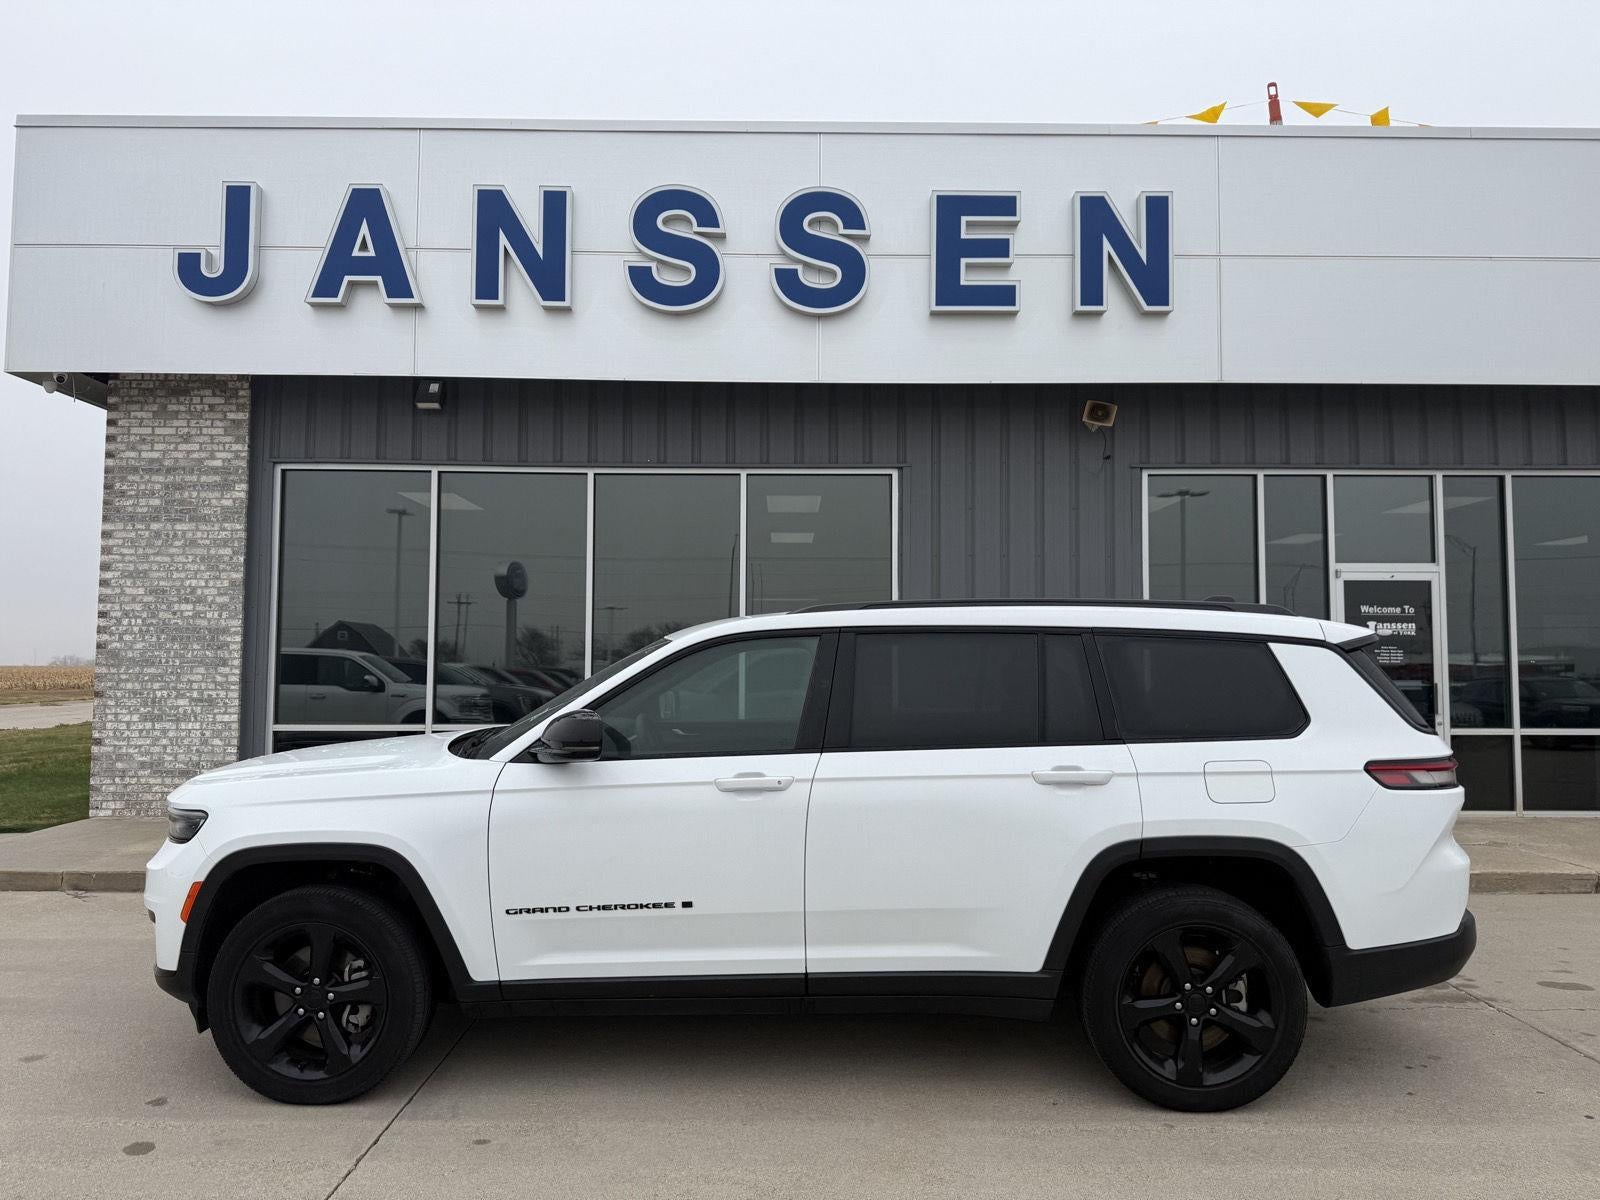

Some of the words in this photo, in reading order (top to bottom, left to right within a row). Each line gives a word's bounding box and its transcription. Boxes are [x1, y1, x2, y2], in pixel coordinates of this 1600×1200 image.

[175, 180, 1175, 314] JANSSEN
[1360, 605, 1402, 614] Welcome
[1403, 605, 1415, 614] To
[505, 905, 570, 915] GRAND
[575, 902, 676, 912] CHEROKEE
